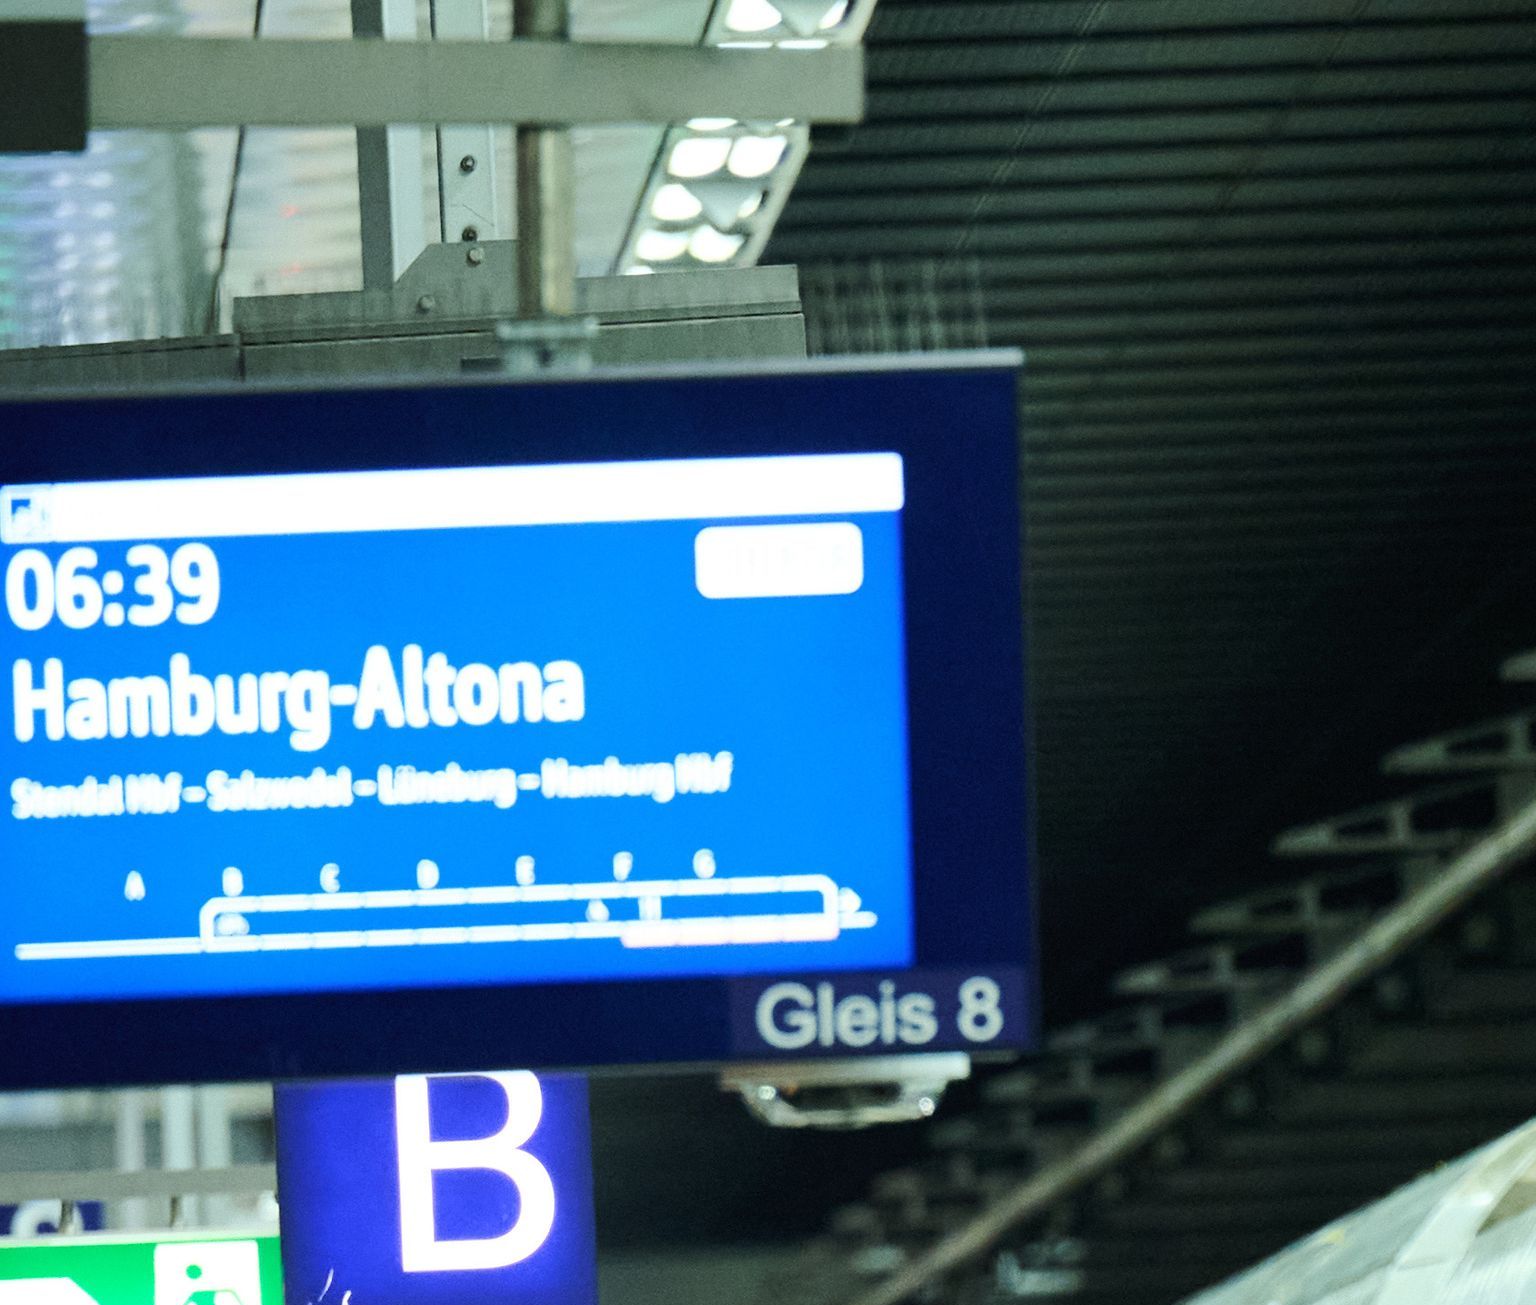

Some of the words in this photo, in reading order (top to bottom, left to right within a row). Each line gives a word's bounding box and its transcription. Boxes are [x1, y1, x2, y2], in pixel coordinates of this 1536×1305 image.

[5, 542, 221, 631] 06:39
[12, 644, 585, 752] Hamburg-Altona
[754, 979, 939, 1050] Gleis
[955, 975, 1005, 1043] 8
[395, 1069, 557, 1273] B
